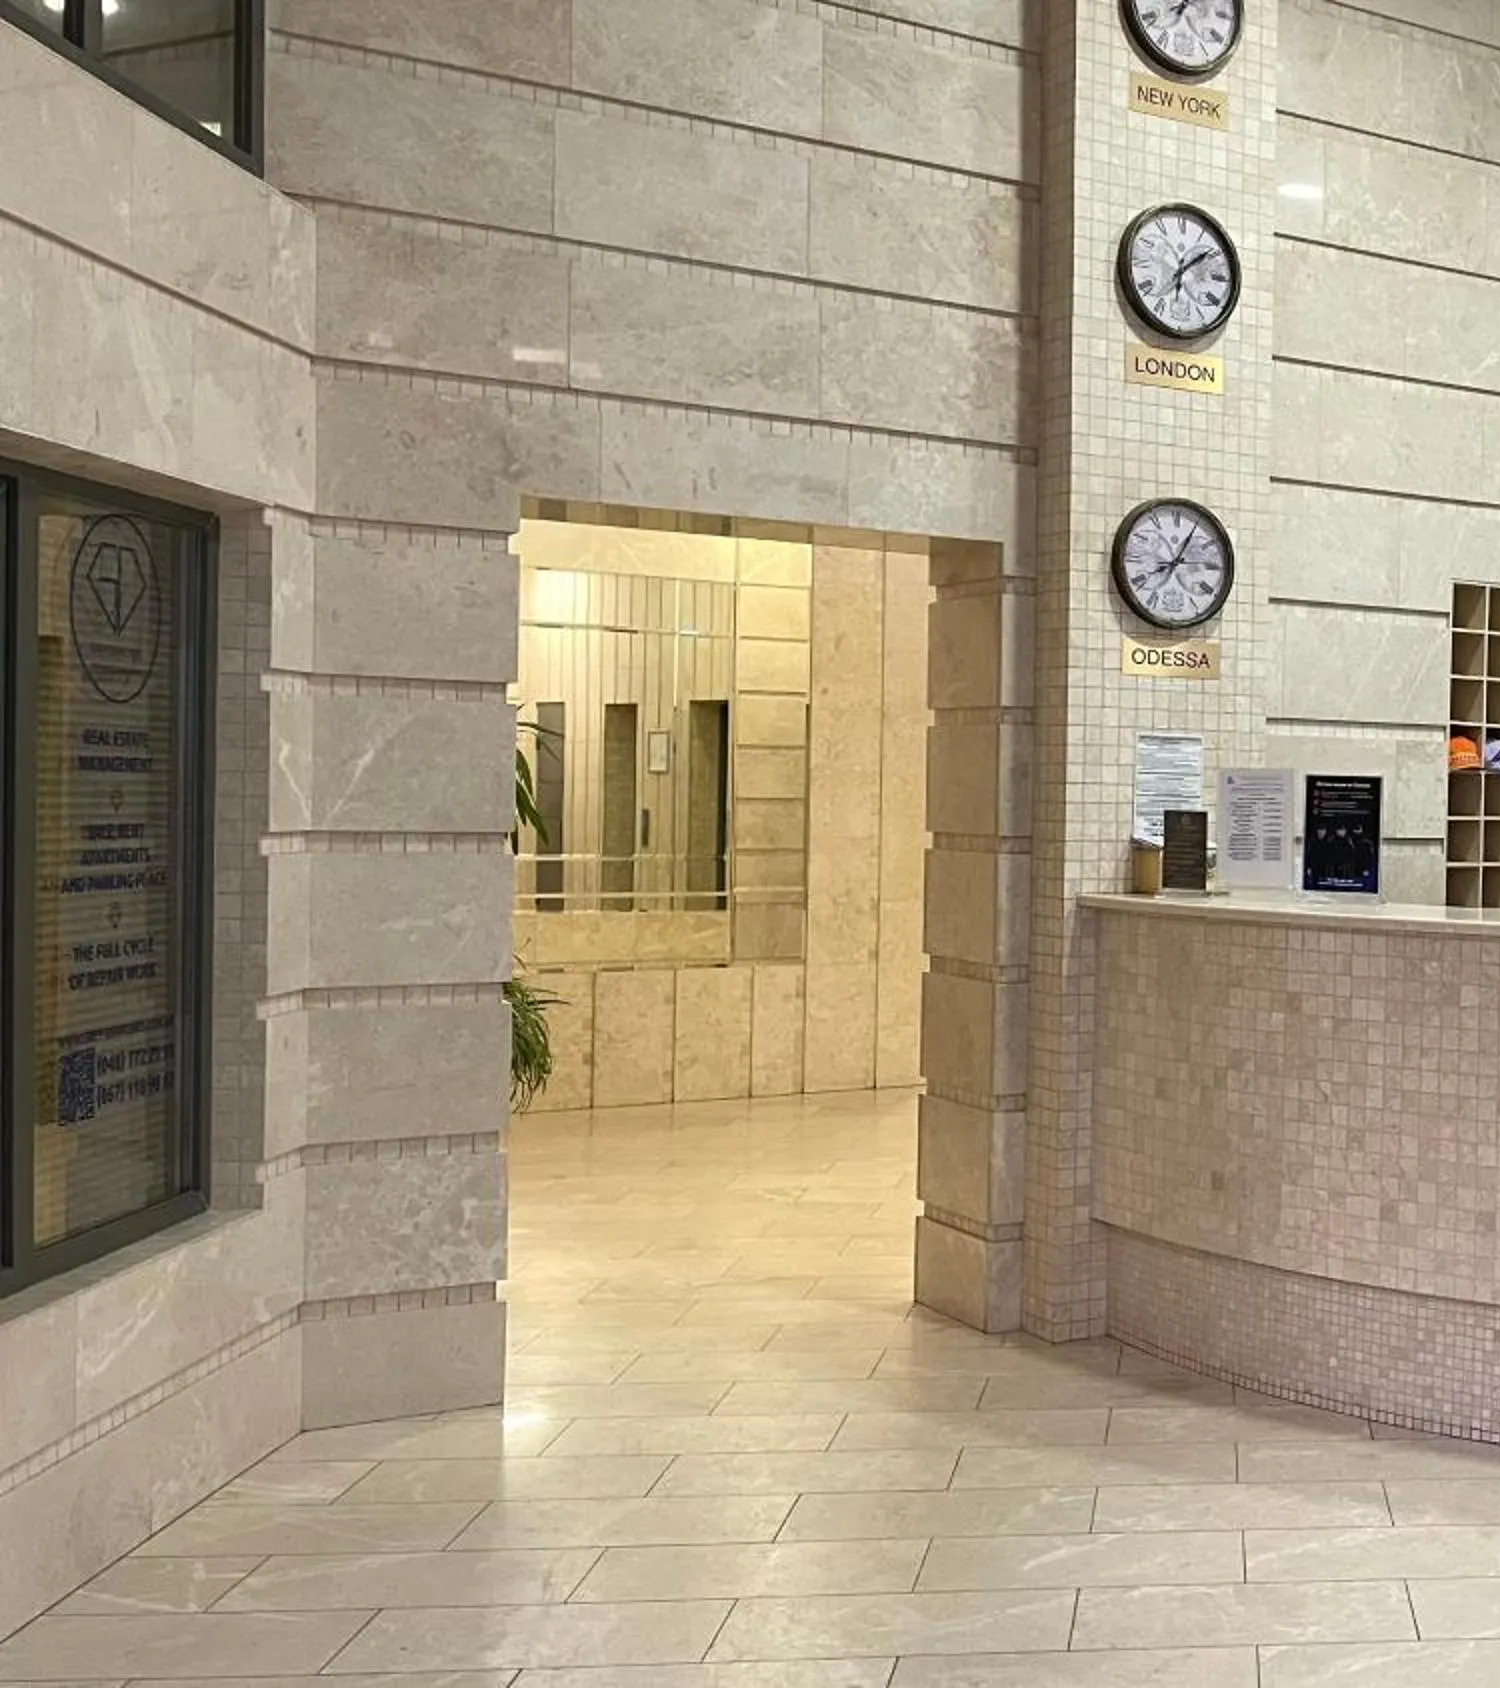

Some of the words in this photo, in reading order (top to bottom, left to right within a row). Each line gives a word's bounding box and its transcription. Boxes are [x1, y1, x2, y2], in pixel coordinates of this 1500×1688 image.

[1137, 86, 1174, 109] NEW
[1178, 94, 1221, 119] YORK
[1135, 356, 1215, 383] LONDON
[1131, 648, 1210, 668] ODESSA
[71, 943, 94, 961] THE
[96, 940, 121, 958] FULL
[123, 936, 154, 956] CYCLE
